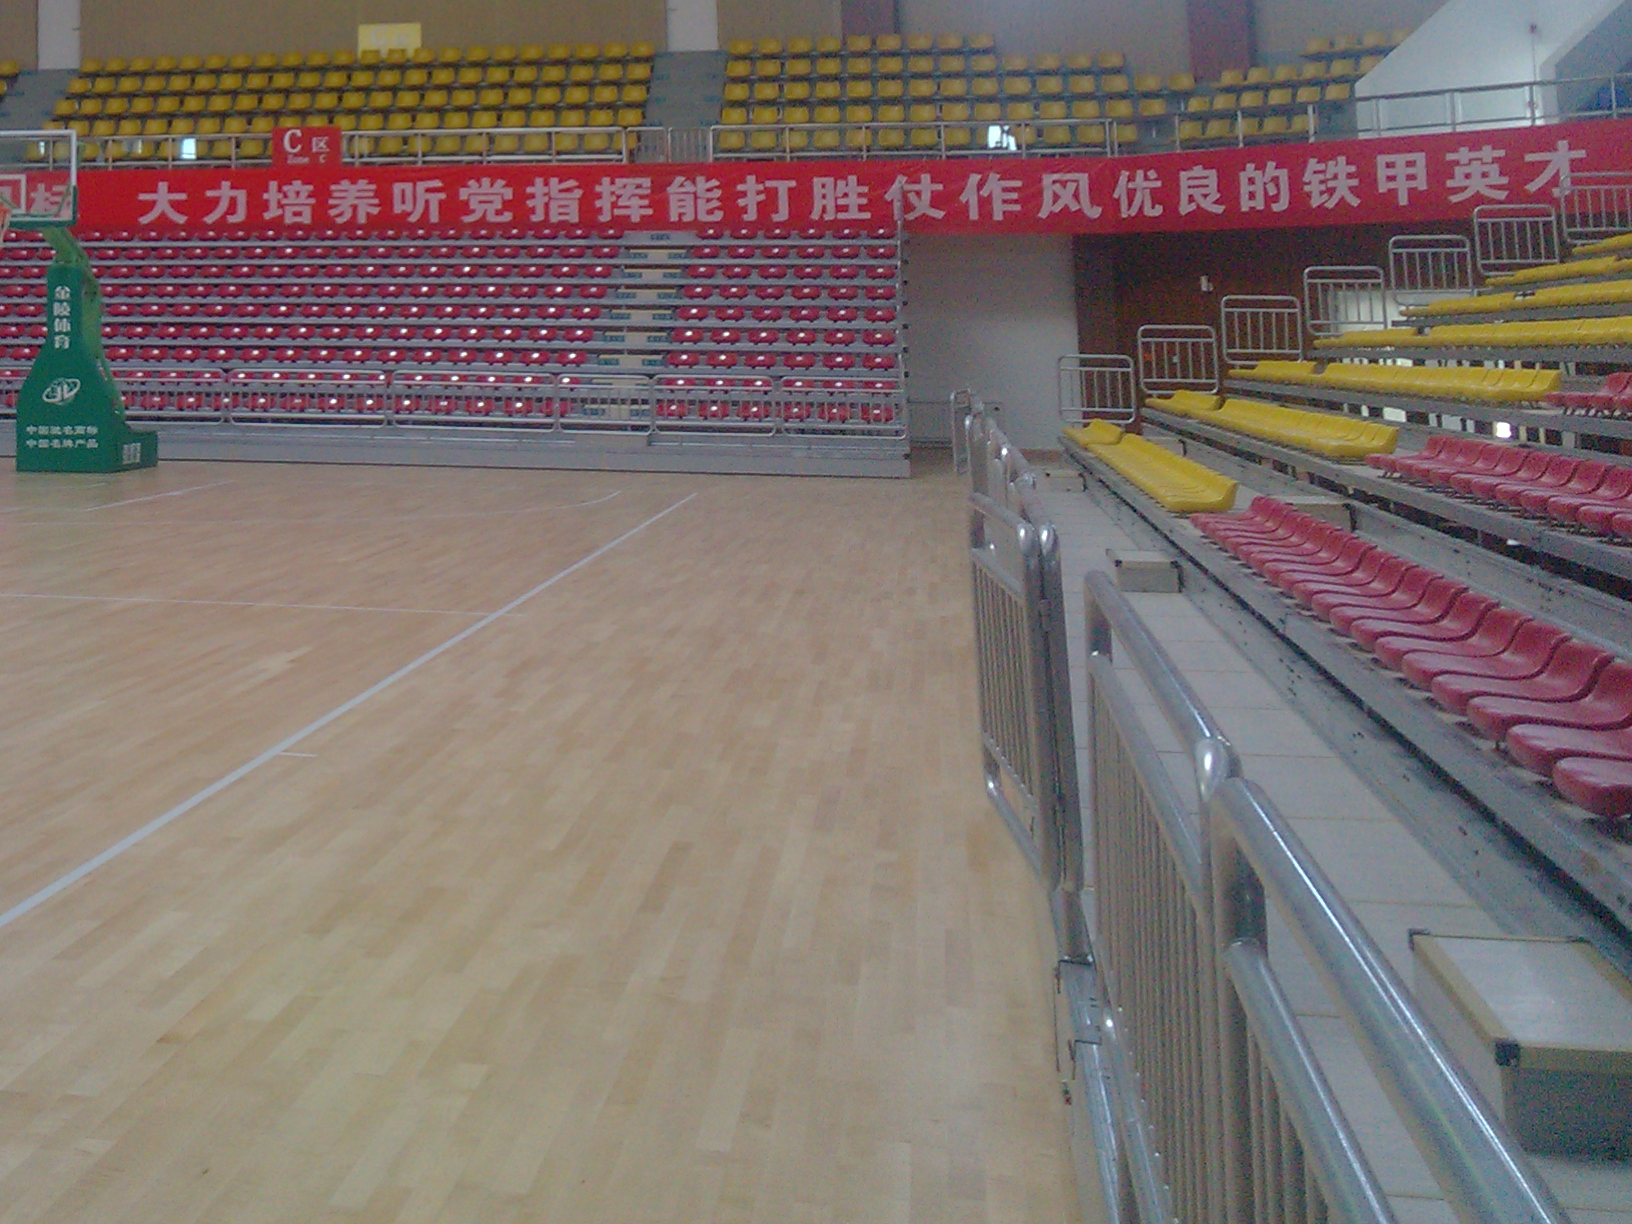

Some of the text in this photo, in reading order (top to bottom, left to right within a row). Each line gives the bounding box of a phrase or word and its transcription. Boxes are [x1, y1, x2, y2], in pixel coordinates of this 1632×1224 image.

[283, 129, 330, 153] C 区
[53, 285, 71, 349] 金陵体育
